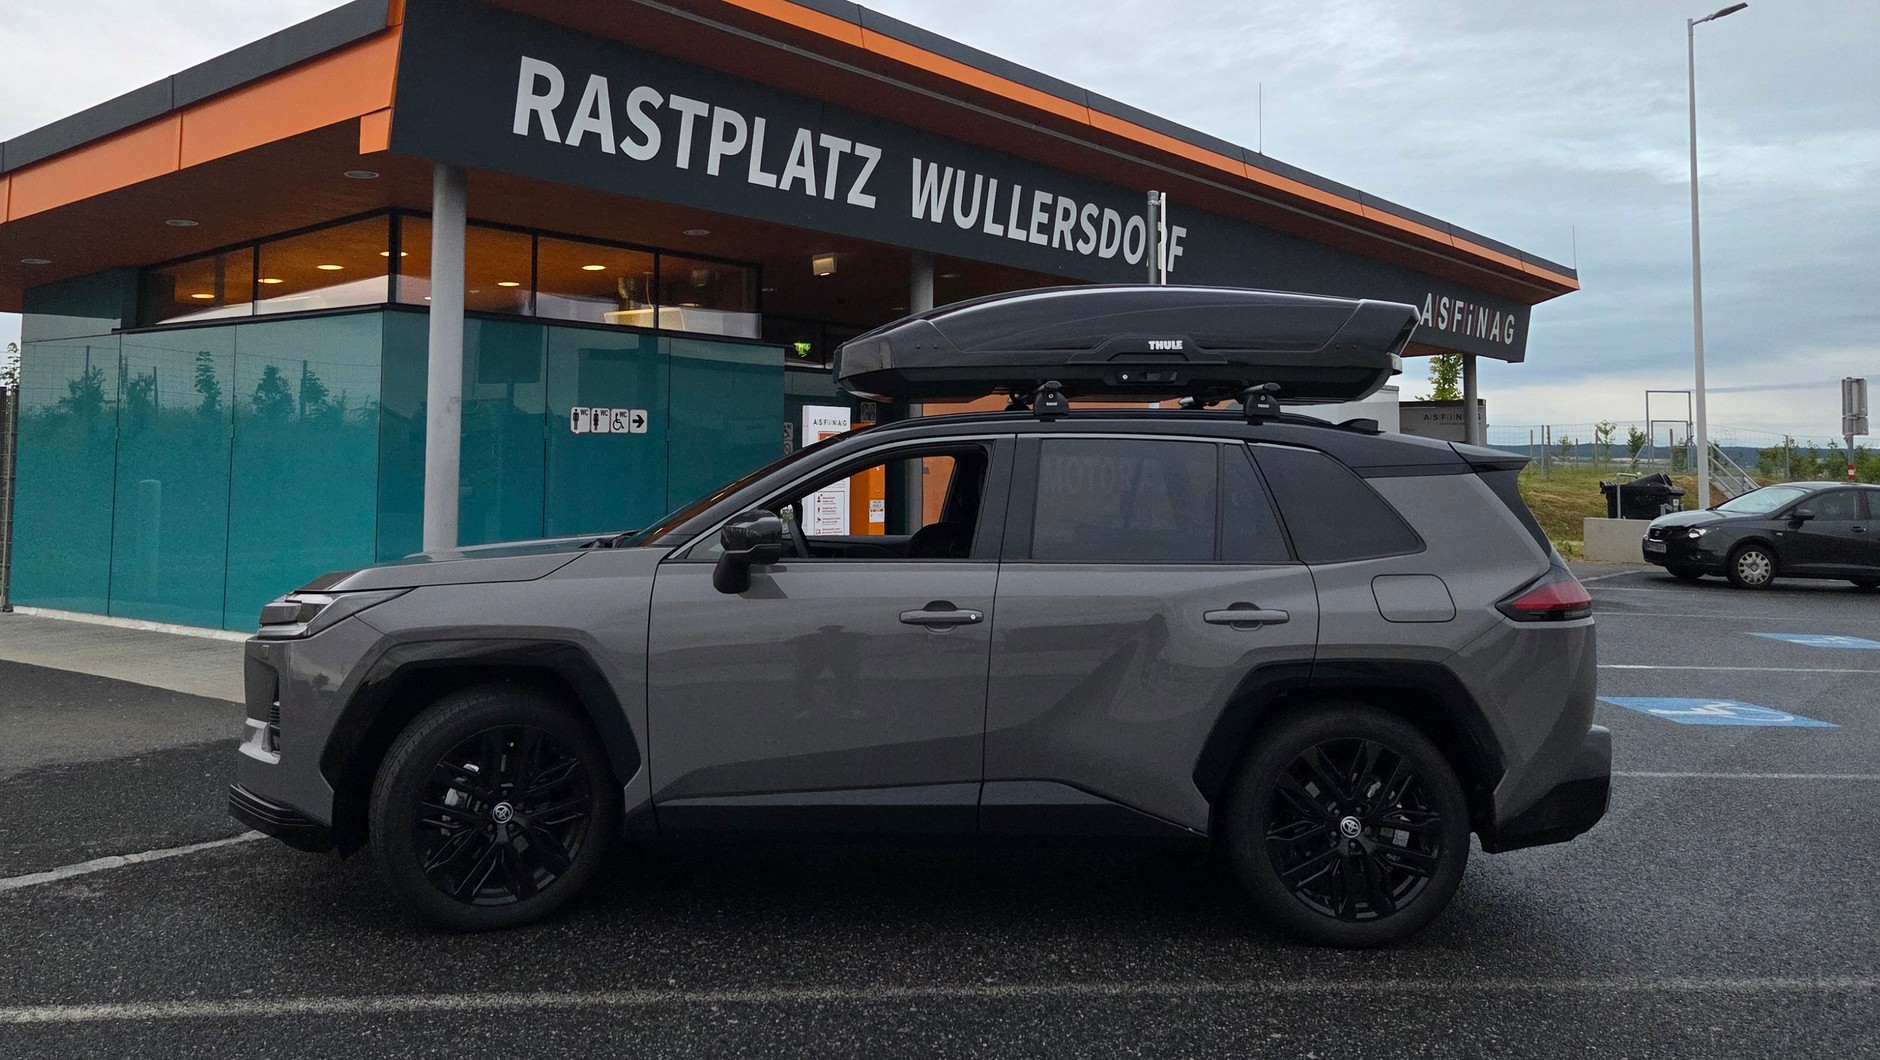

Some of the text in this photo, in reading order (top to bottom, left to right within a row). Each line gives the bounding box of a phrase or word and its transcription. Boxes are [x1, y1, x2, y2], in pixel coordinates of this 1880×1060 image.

[512, 55, 883, 209] RASTPLATZ
[1148, 340, 1183, 350] THULE
[600, 409, 609, 417] WC
